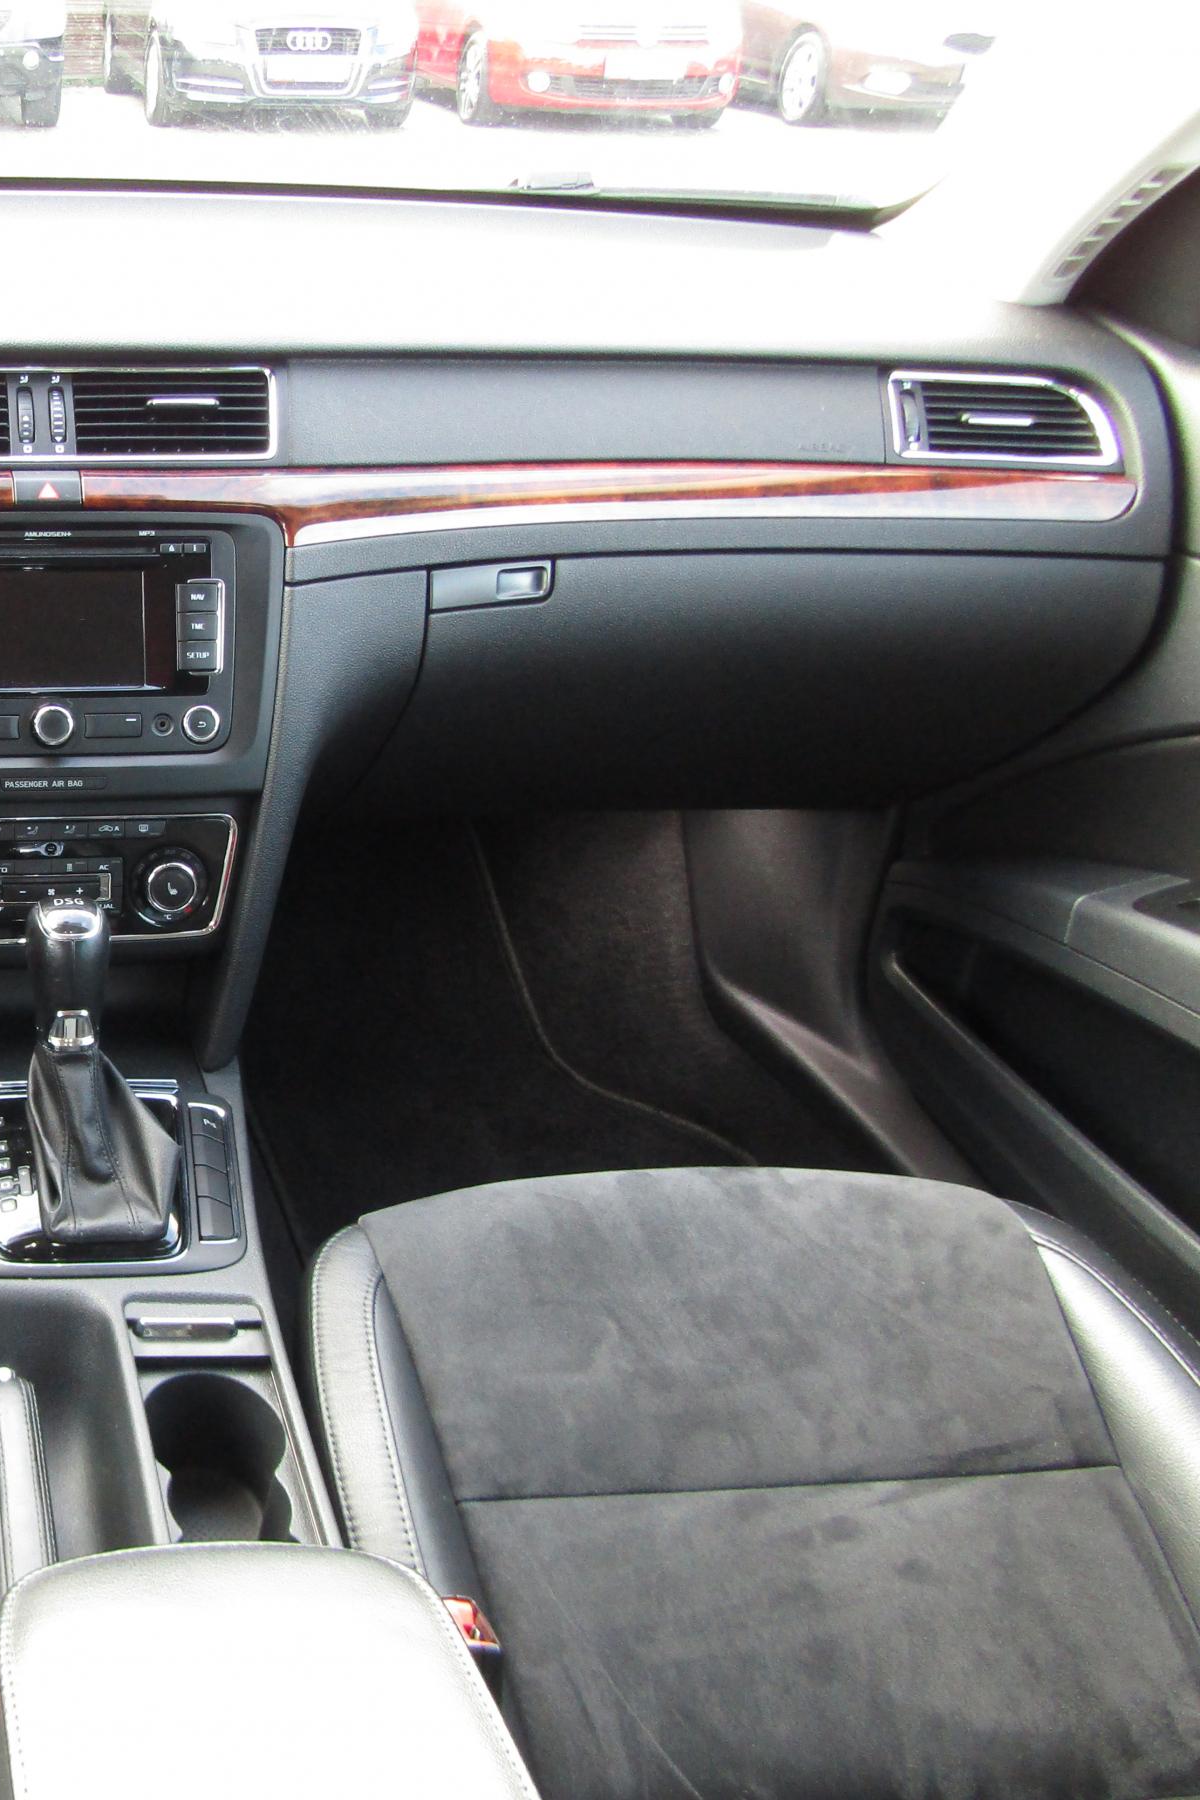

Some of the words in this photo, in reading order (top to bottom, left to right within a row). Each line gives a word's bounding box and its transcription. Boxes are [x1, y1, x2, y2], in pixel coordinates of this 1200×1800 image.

[190, 593, 205, 601] NAV
[186, 651, 210, 659] SETUP
[4, 780, 49, 788] PASSENGER
[51, 780, 65, 788] AIR
[53, 897, 85, 906] DSG
